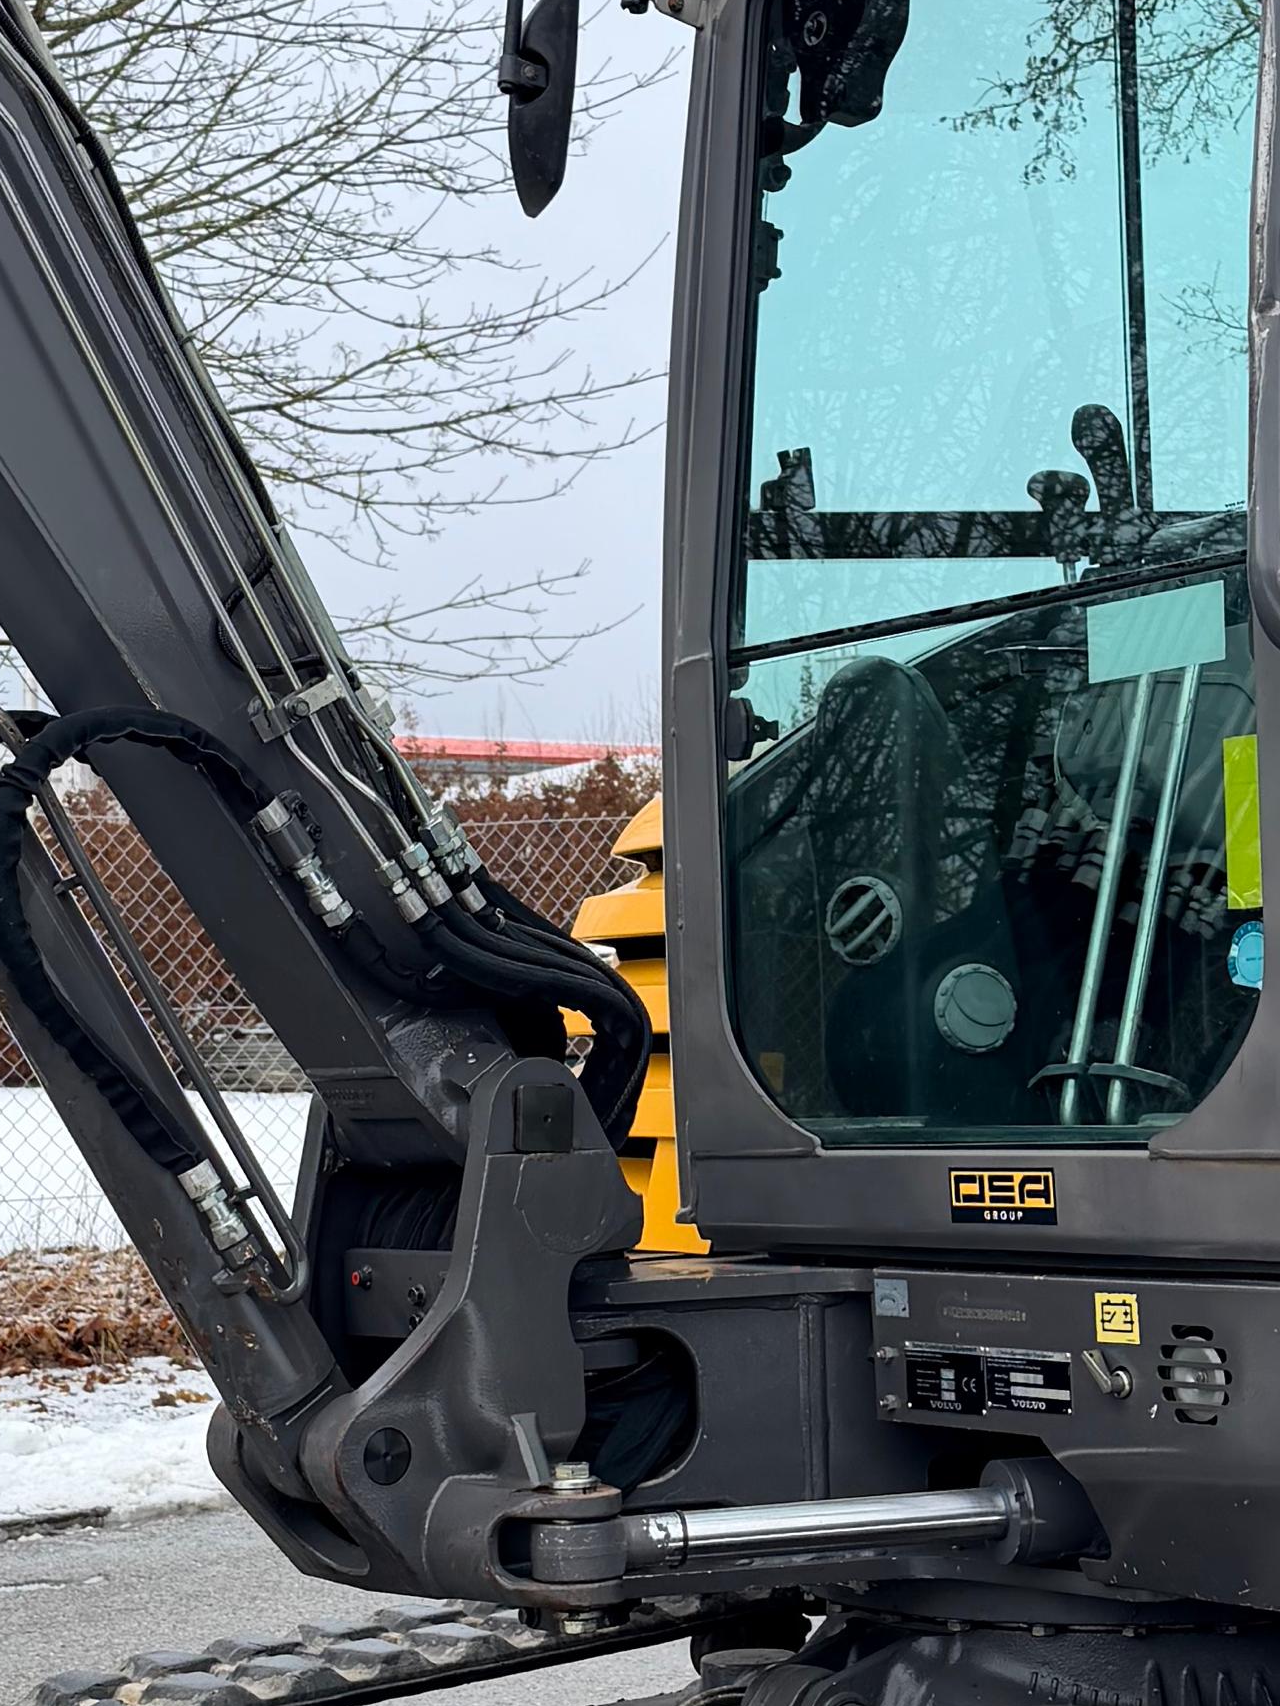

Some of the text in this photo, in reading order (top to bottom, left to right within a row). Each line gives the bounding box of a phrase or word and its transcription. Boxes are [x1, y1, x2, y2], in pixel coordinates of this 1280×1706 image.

[984, 1210, 1023, 1221] GROUP
[930, 1399, 962, 1411] VOLVO
[1011, 1398, 1047, 1411] VOLVO
